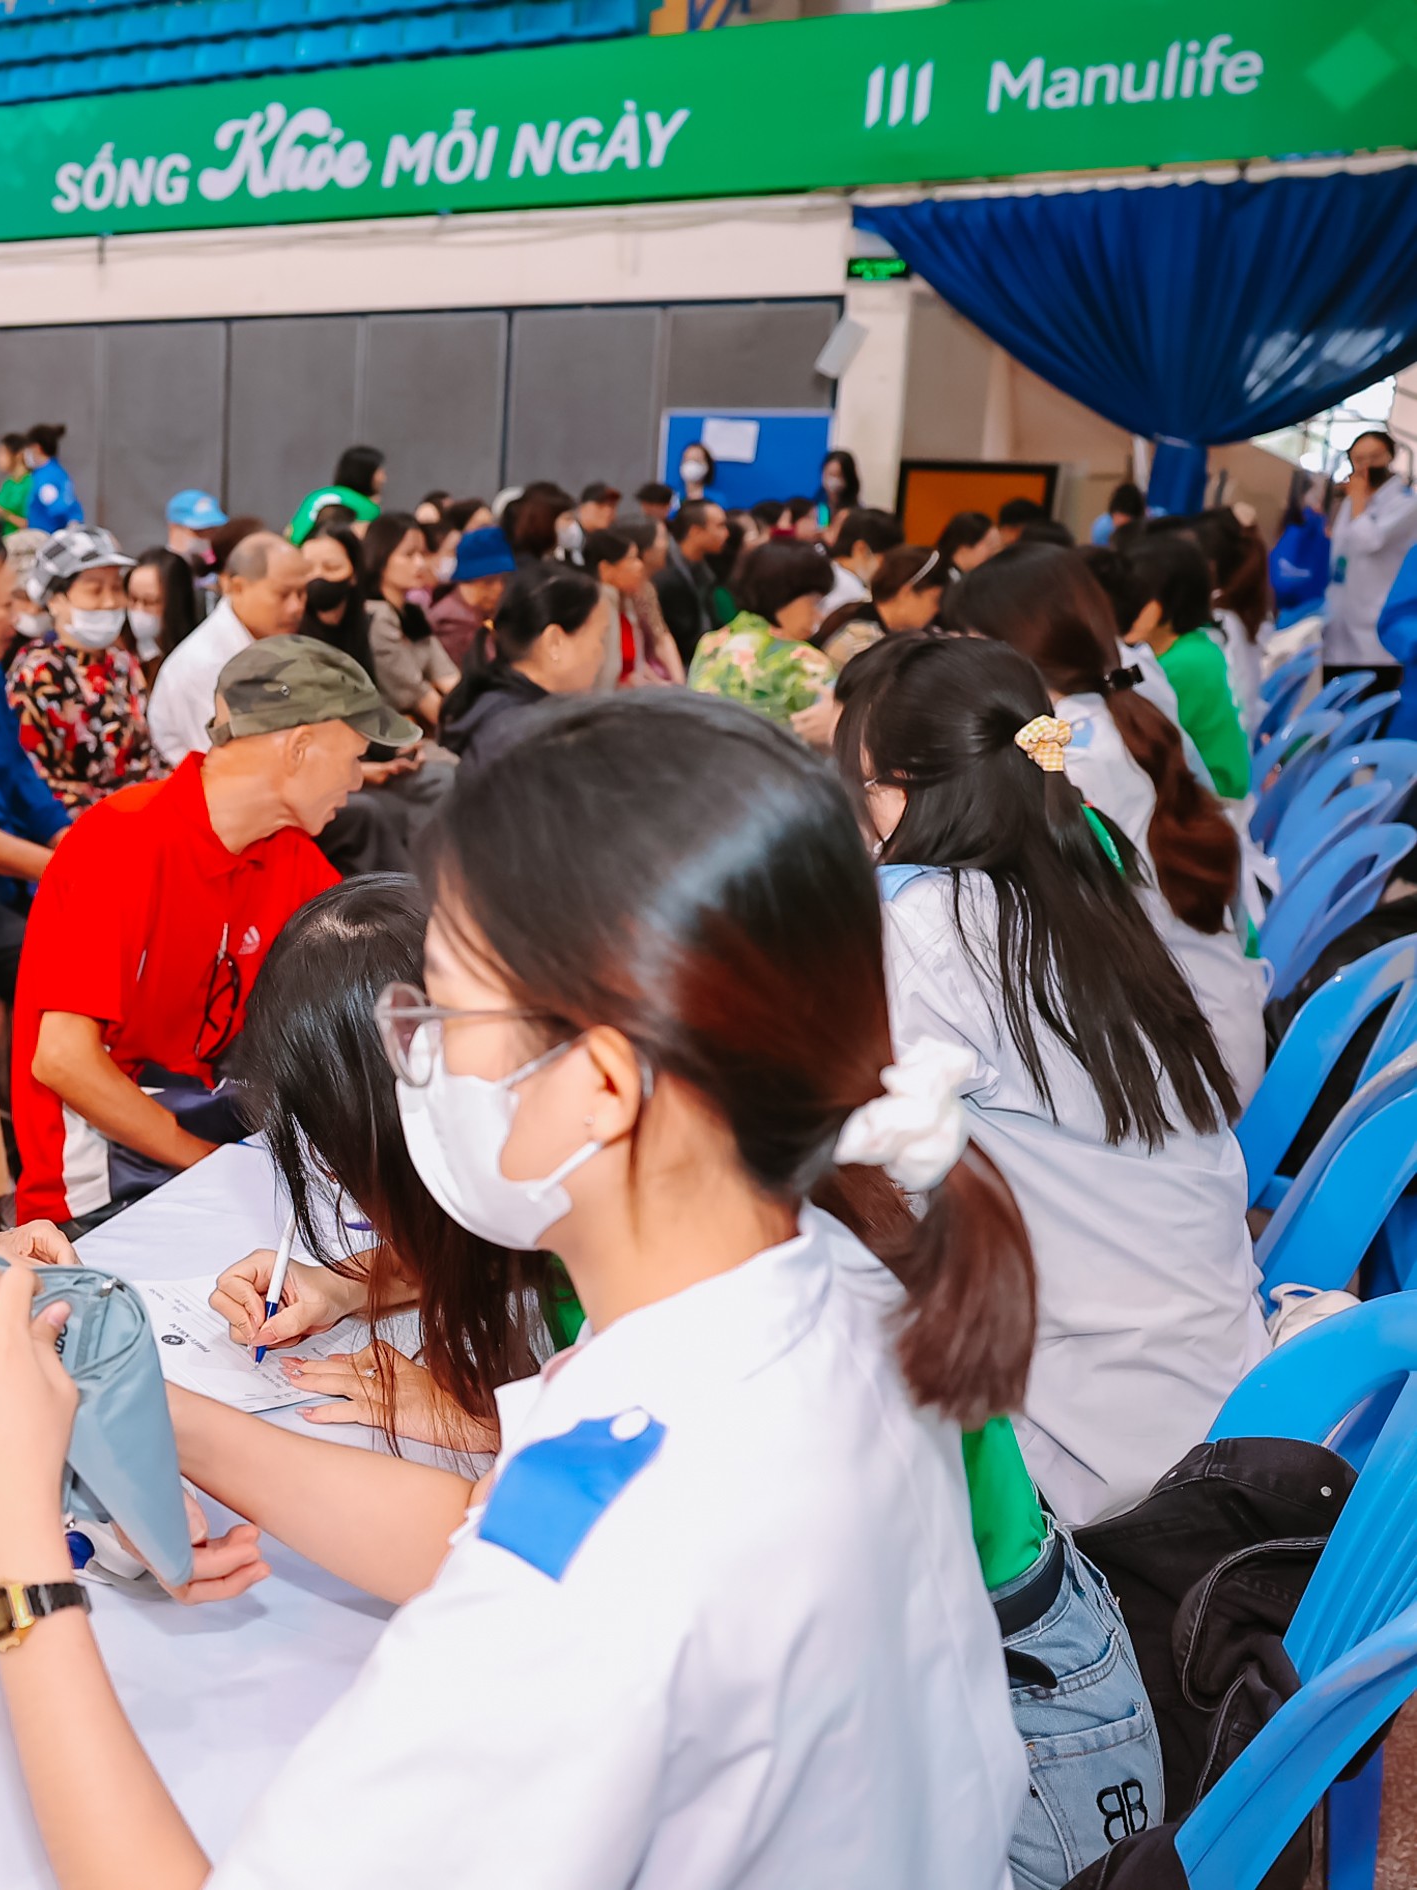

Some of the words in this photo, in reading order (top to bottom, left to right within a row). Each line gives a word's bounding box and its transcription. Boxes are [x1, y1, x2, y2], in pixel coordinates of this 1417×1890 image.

[987, 34, 1264, 113] Manulife
[51, 141, 191, 213] SỐNG
[381, 108, 499, 188] MỖI
[508, 100, 690, 178] NGÀY
